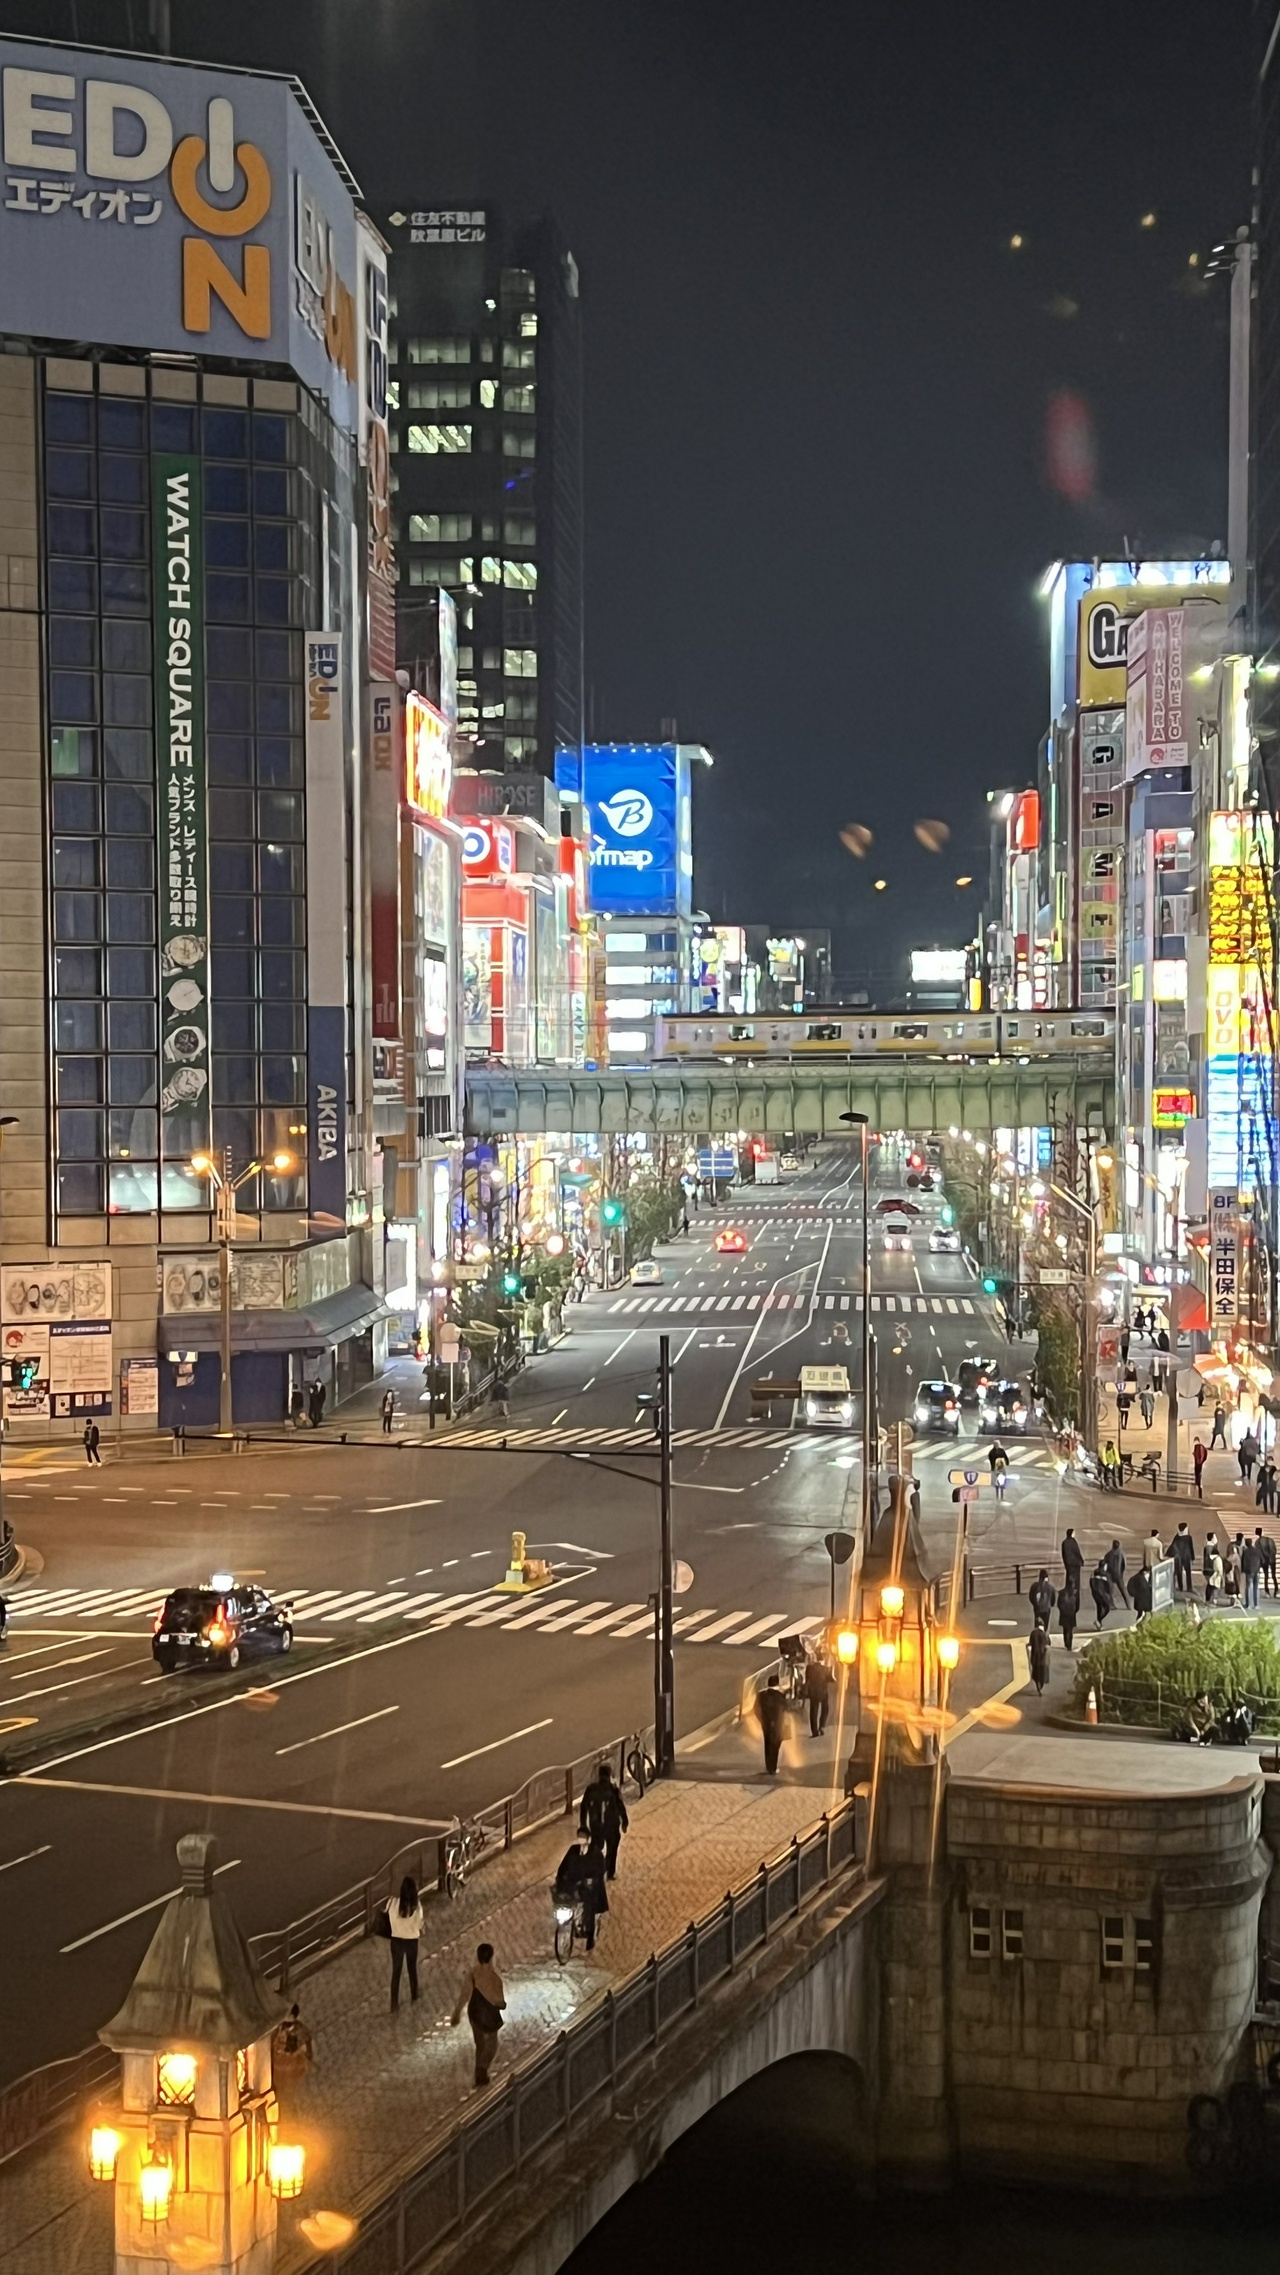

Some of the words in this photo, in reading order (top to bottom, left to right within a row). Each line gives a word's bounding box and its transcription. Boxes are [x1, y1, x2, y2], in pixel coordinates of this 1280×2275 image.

[5, 178, 162, 225] エディオン
[166, 472, 190, 609] WATCH
[166, 616, 194, 768] SQUARE
[1151, 621, 1167, 742] AKIHABARA
[1168, 611, 1184, 708] WELCOME
[1168, 711, 1182, 740] TO
[1215, 990, 1233, 1044] DVD
[317, 1085, 338, 1161] AKIBA
[1213, 1195, 1236, 1208] 8F
[1215, 1238, 1235, 1316] 半田保全
